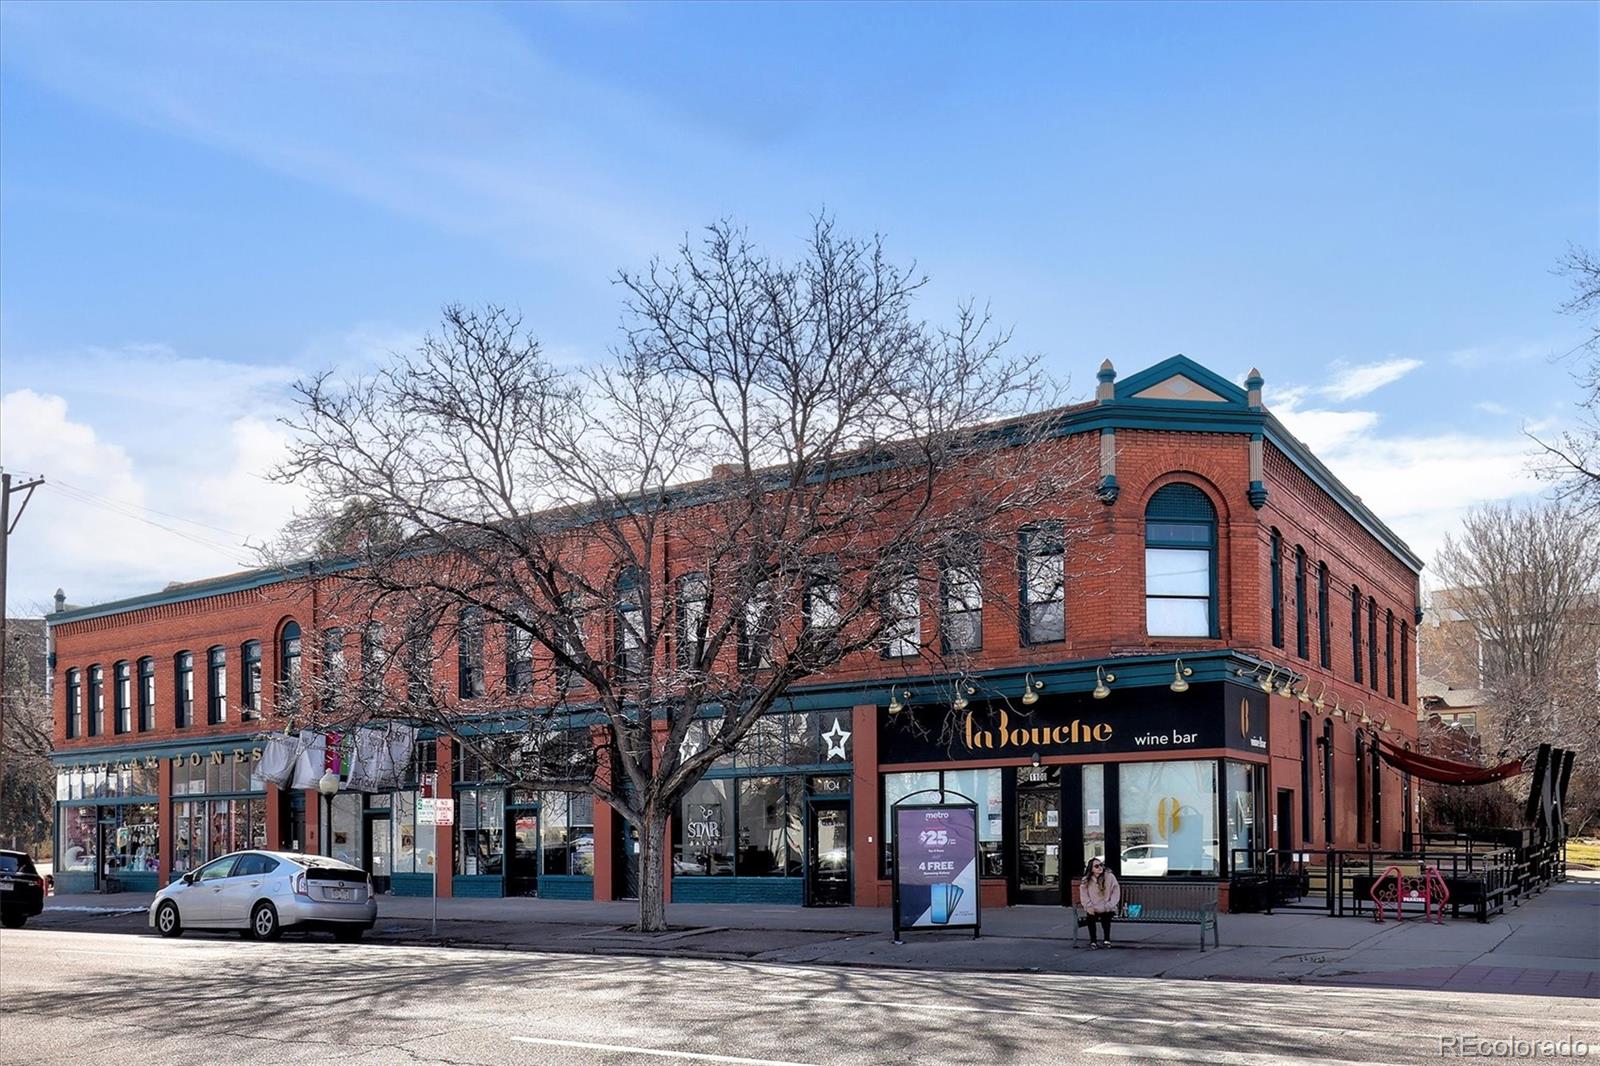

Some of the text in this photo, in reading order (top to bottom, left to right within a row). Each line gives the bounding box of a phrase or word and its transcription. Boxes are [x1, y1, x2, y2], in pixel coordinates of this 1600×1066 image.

[1134, 729, 1198, 746] wine bar
[173, 747, 262, 768] JONES
[926, 811, 949, 821] metro
[920, 830, 948, 846] $25
[918, 861, 954, 871] 4 FREE
